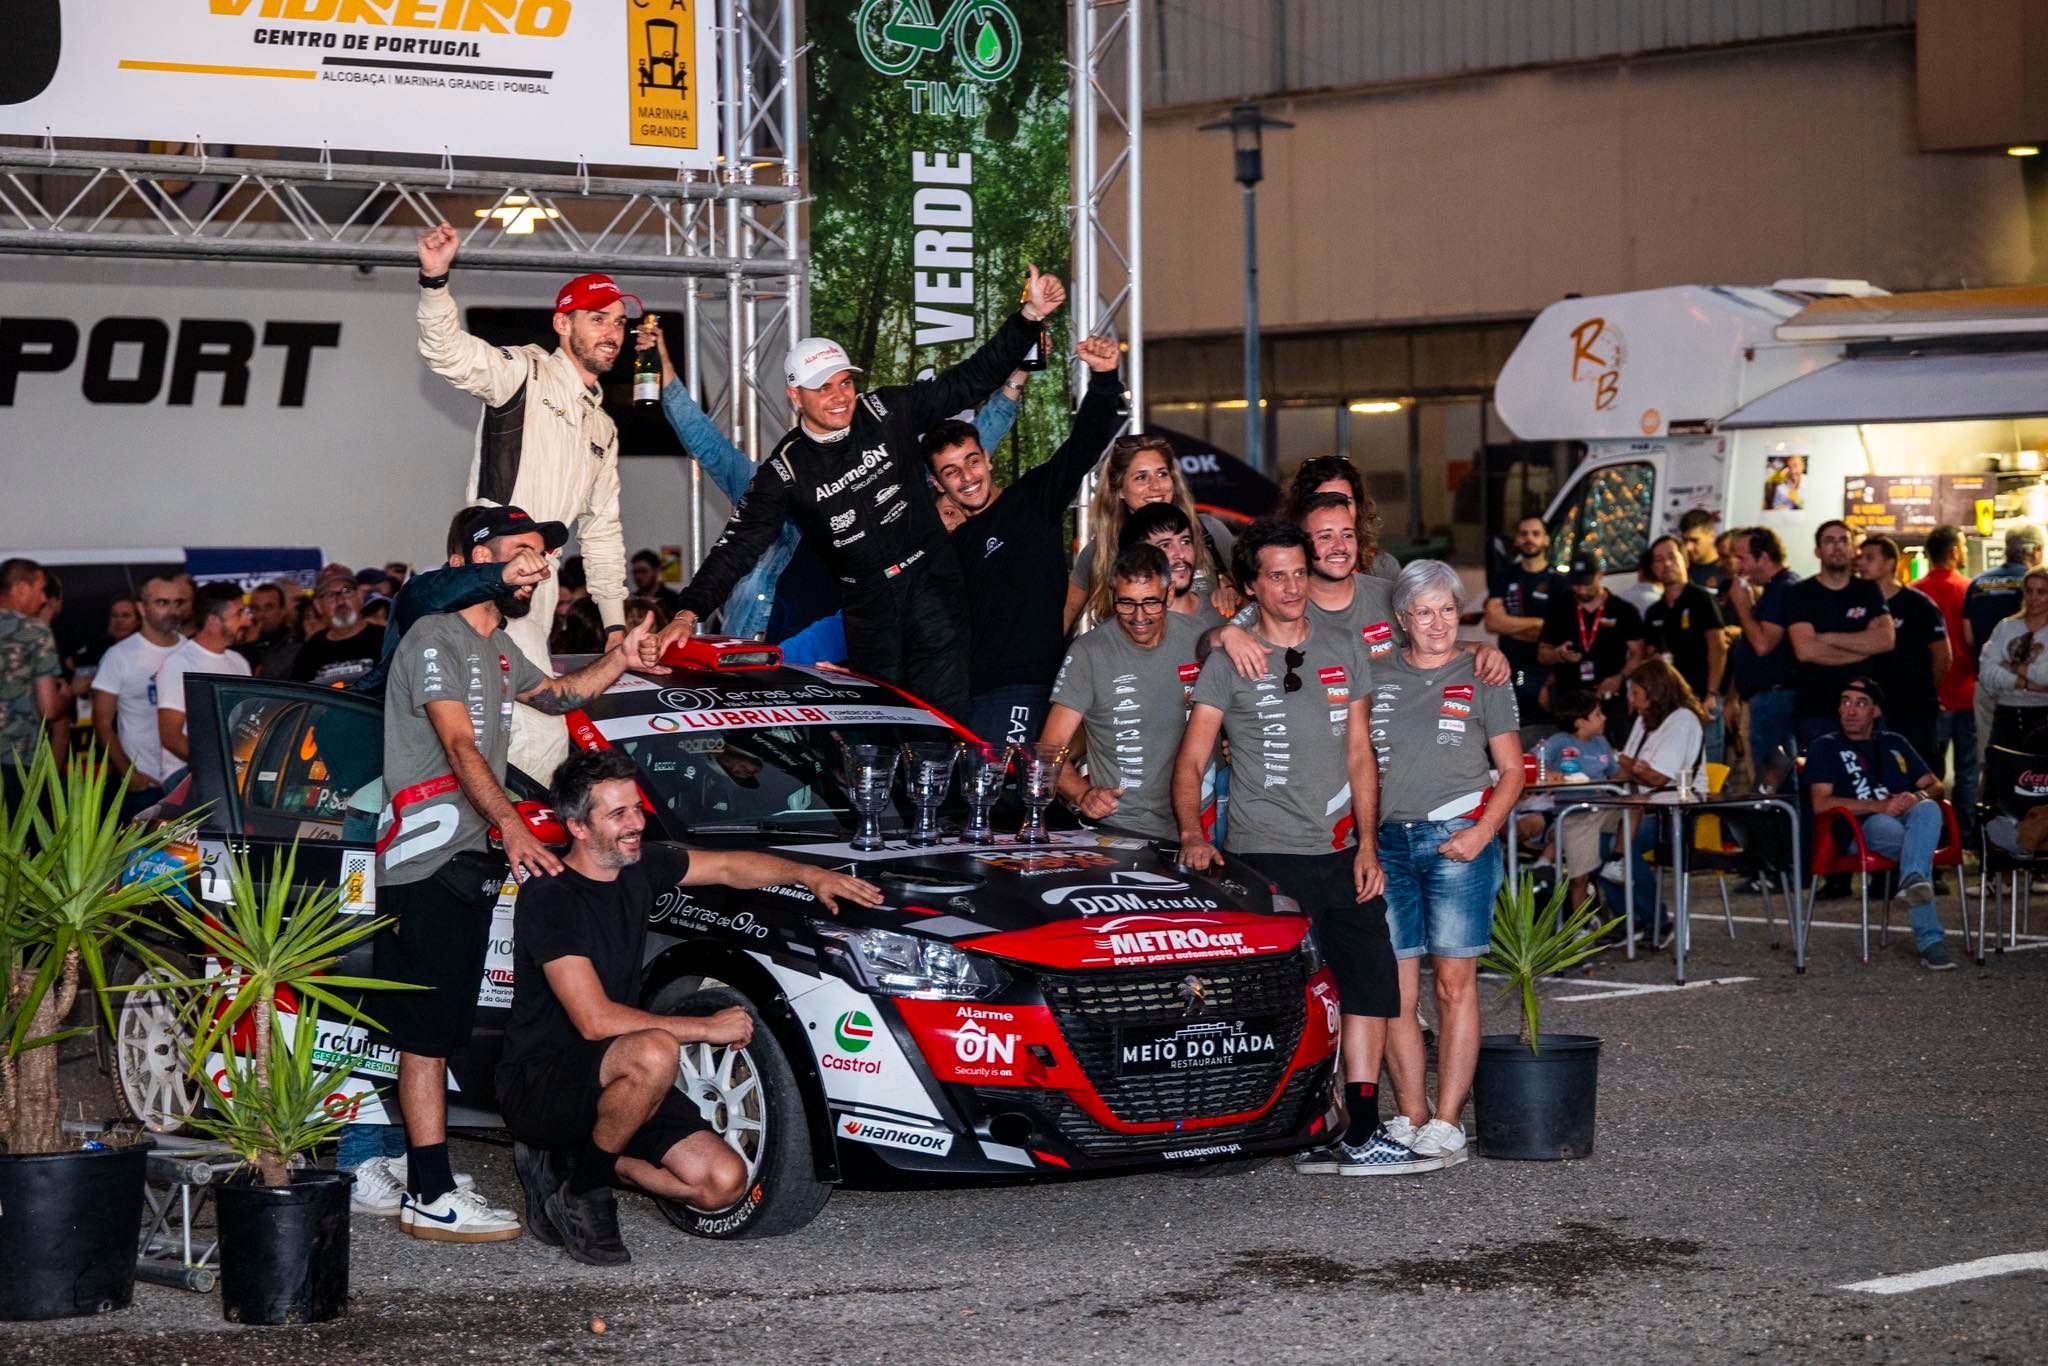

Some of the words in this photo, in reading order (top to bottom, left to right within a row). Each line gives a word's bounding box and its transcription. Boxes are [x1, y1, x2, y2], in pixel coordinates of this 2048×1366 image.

[254, 28, 336, 48] CENTRO
[342, 34, 369, 50] DE
[374, 36, 480, 57] PORTUGAL
[322, 71, 385, 85] ALCOBAÇA
[394, 74, 445, 87] MARINHA
[448, 78, 494, 91] GRANDE
[503, 82, 549, 94] POMBAL
[638, 107, 689, 121] MARINHA
[641, 124, 686, 138] GRANDE
[912, 150, 975, 346] VERDE
[1181, 454, 1219, 473] OK
[851, 472, 878, 492] Security
[907, 550, 925, 565] SILVA
[694, 687, 791, 701] Terras
[682, 707, 832, 728] LUBRIALBI
[778, 886, 815, 902] BRANCO
[674, 893, 719, 923] Terras
[716, 915, 731, 927] de
[731, 912, 768, 938] Oiro
[1110, 927, 1244, 955] METROcar
[1114, 955, 1145, 966] peças
[1148, 953, 1173, 964] para
[956, 1006, 1014, 1021] Alarme
[1122, 1043, 1178, 1063] MEIO
[1187, 1039, 1214, 1058] DO
[1223, 1034, 1275, 1054] NADA
[821, 1053, 881, 1075] Castrol
[955, 1066, 989, 1077] Security
[991, 1067, 998, 1076] is
[1170, 1055, 1233, 1069] RESTAURANTE
[1163, 1142, 1242, 1161] terrasdeoiro.pt
